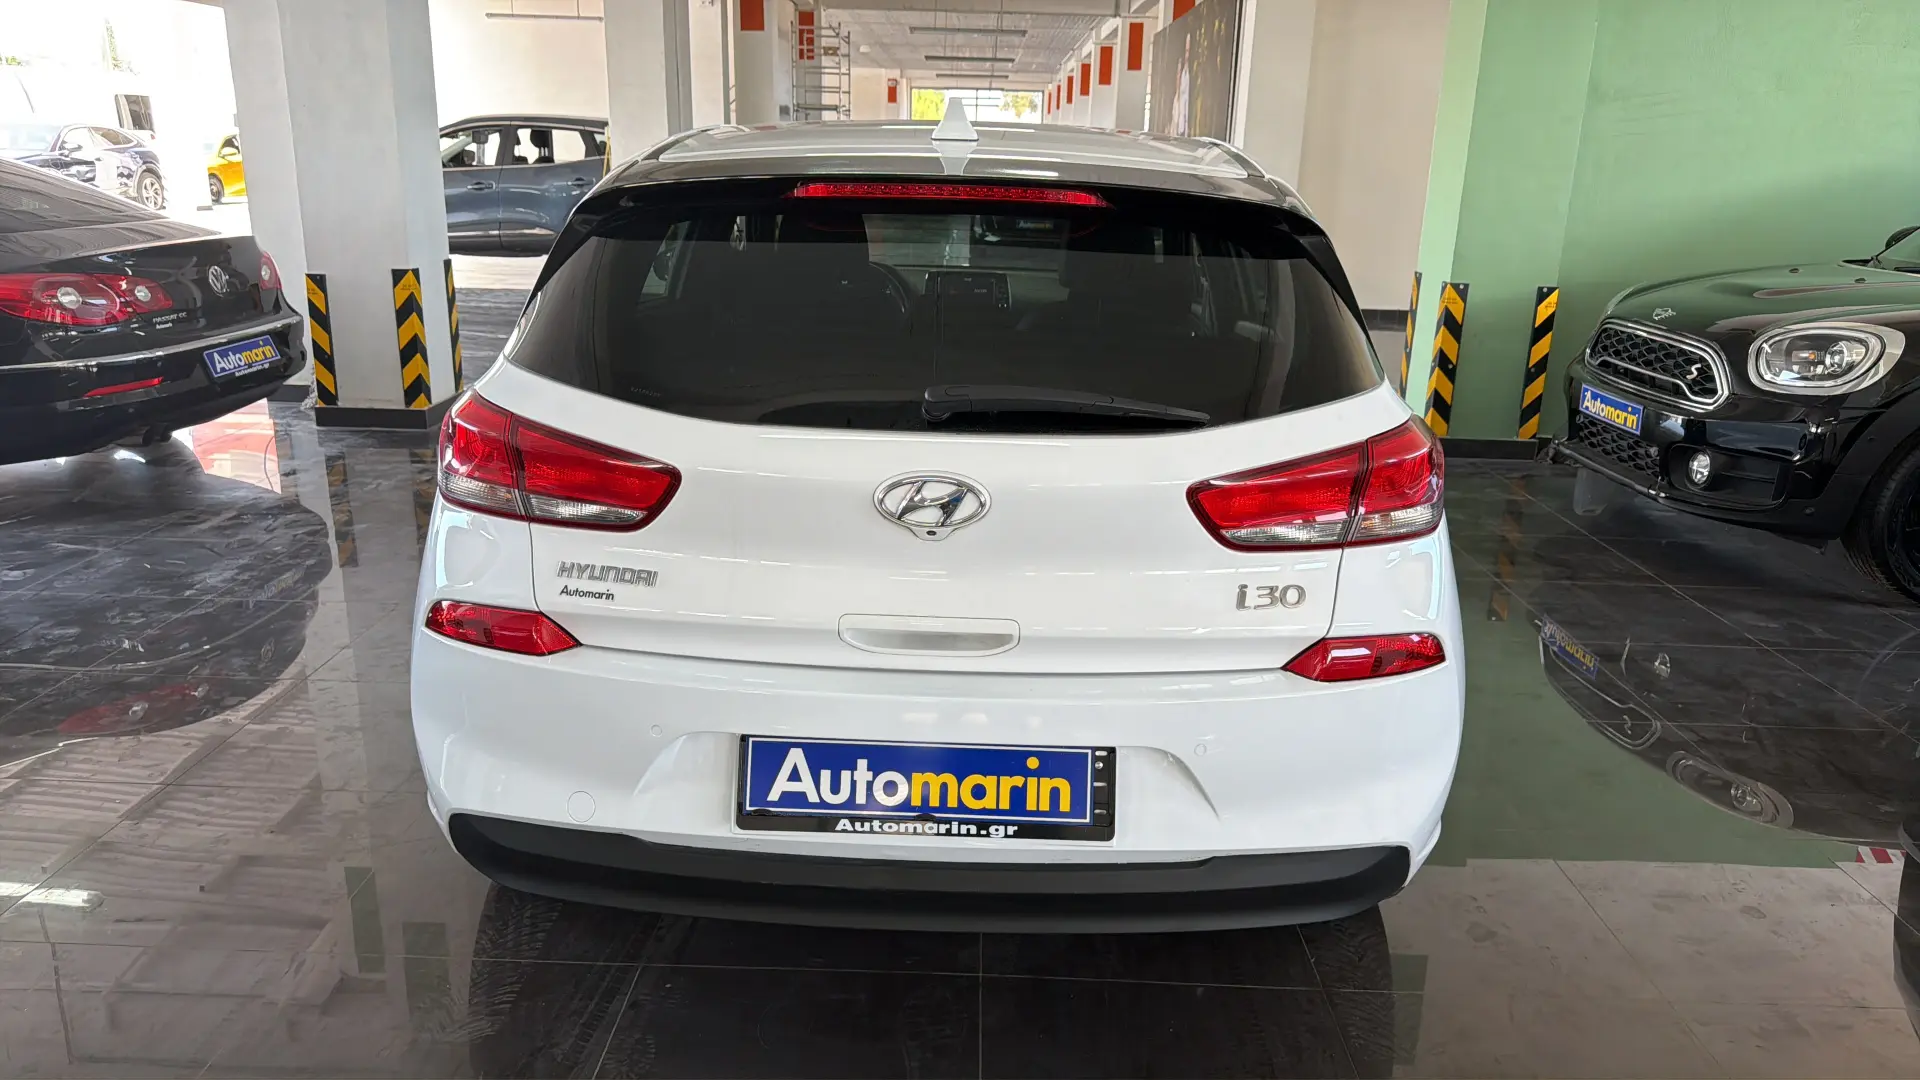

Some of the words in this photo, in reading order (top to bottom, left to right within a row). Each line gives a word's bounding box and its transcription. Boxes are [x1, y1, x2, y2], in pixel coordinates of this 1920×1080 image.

[213, 340, 276, 373] Automarin
[1583, 390, 1639, 429] Automarin
[557, 560, 659, 588] HYUNDAI
[559, 584, 615, 601] Automarin
[1236, 583, 1307, 611] i30
[766, 747, 1071, 813] Automarin
[834, 818, 1018, 838] Automarin.gr
